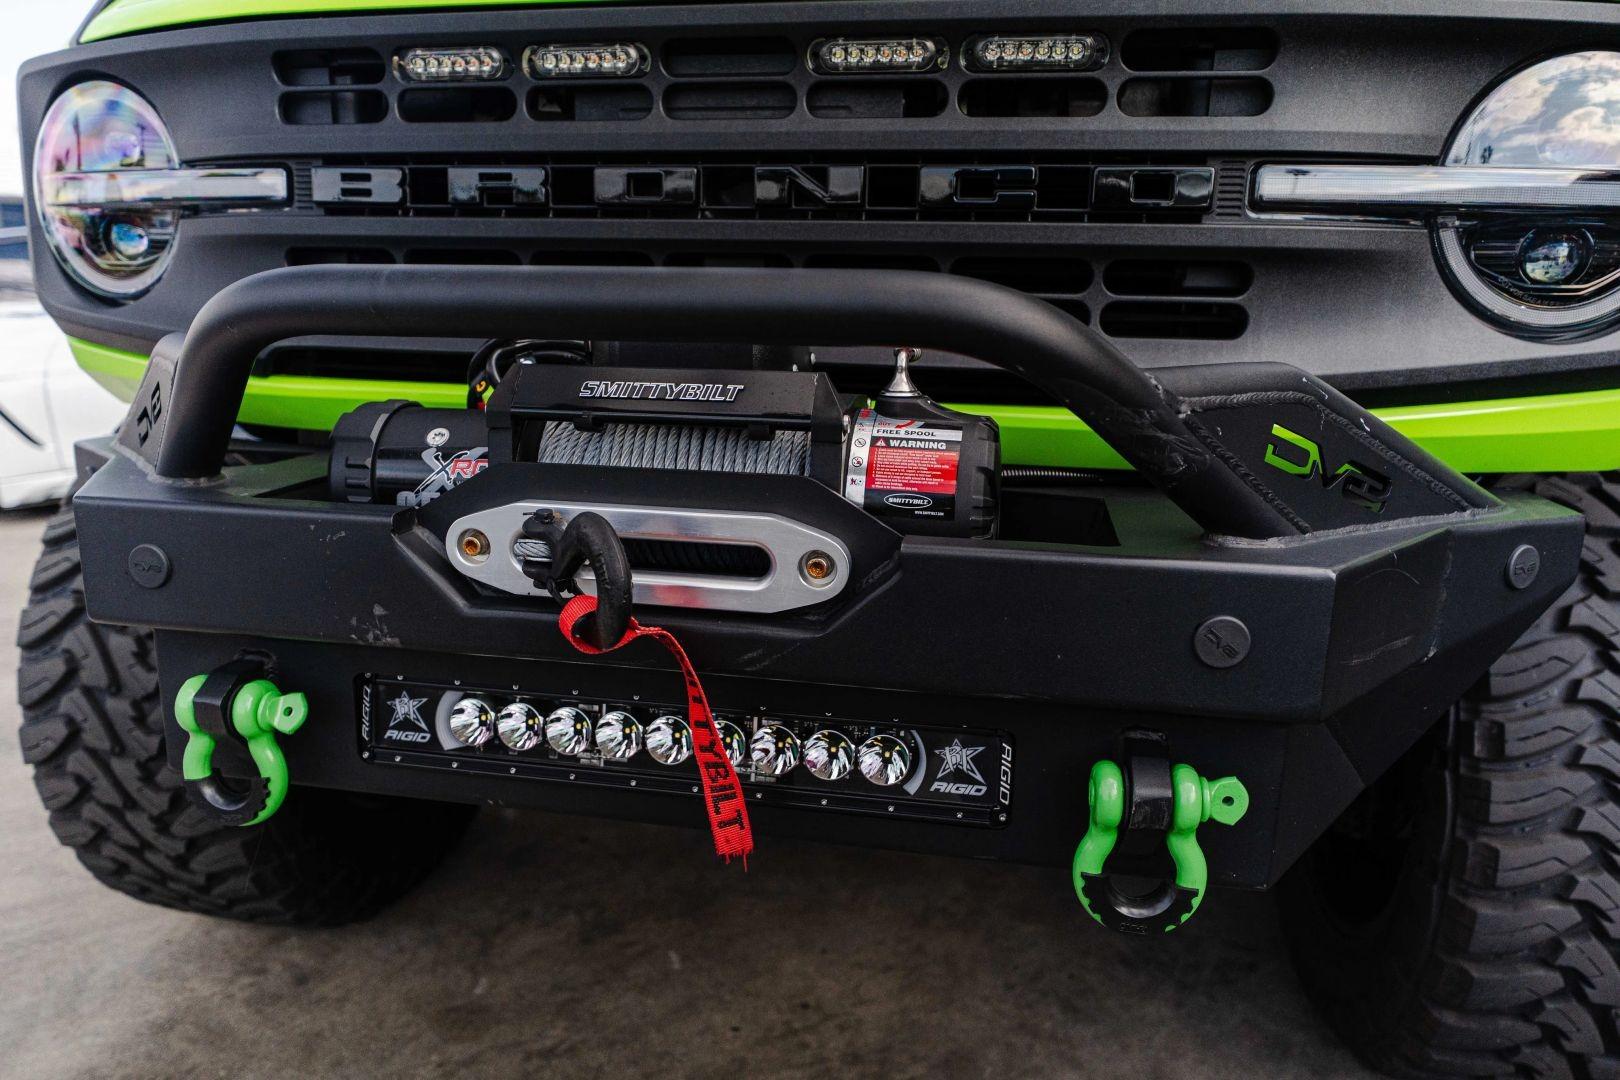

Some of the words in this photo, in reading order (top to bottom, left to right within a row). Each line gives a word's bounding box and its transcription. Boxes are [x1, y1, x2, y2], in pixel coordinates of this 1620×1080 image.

[312, 166, 1215, 207] BRONCO
[579, 380, 744, 402] SMITTYBILT
[904, 429, 937, 437] SPOOL
[889, 439, 947, 450] WARNING
[361, 685, 372, 741] RIGID
[384, 729, 432, 744] RIGID
[1000, 742, 1012, 805] RIGID
[929, 781, 988, 797] RIGID
